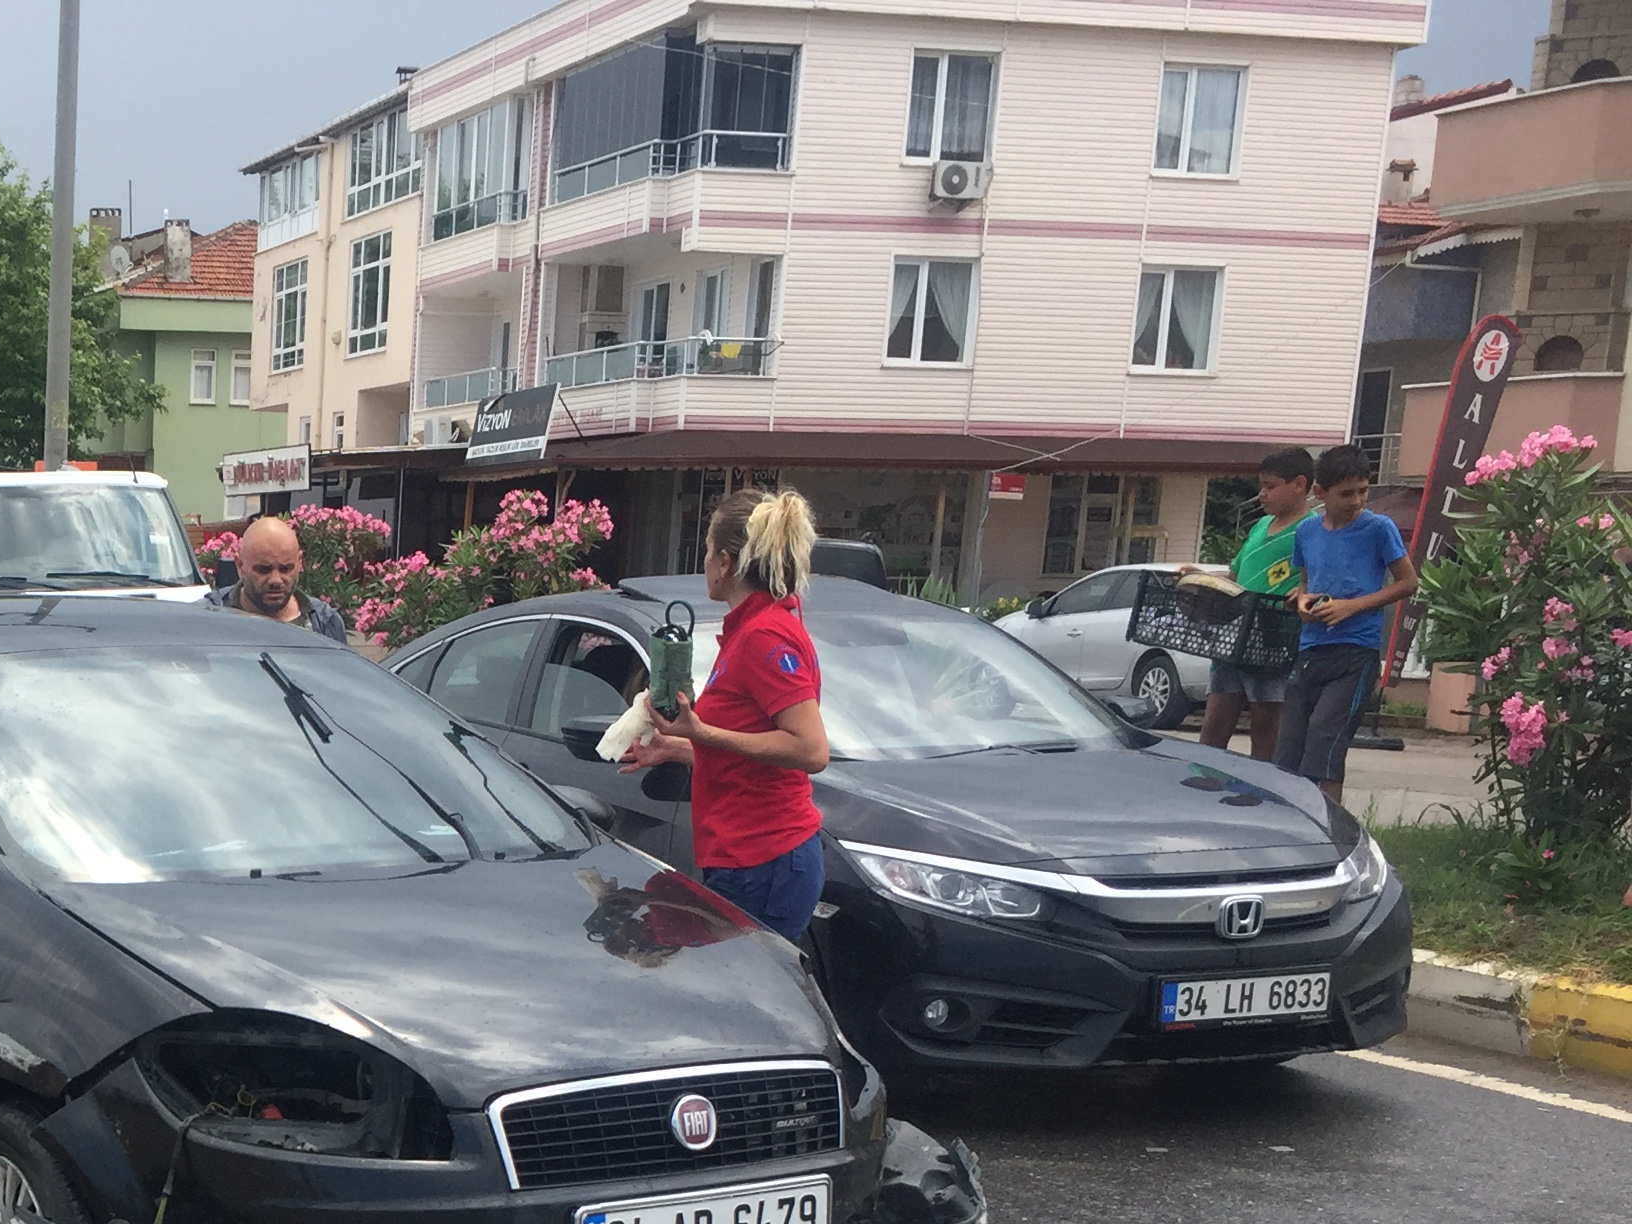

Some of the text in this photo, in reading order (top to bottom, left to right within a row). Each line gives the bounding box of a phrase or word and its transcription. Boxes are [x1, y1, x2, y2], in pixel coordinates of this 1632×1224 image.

[735, 468, 777, 480] VYON
[1164, 977, 1327, 1018] TR 34 LH 6833
[683, 1110, 709, 1137] FIAT
